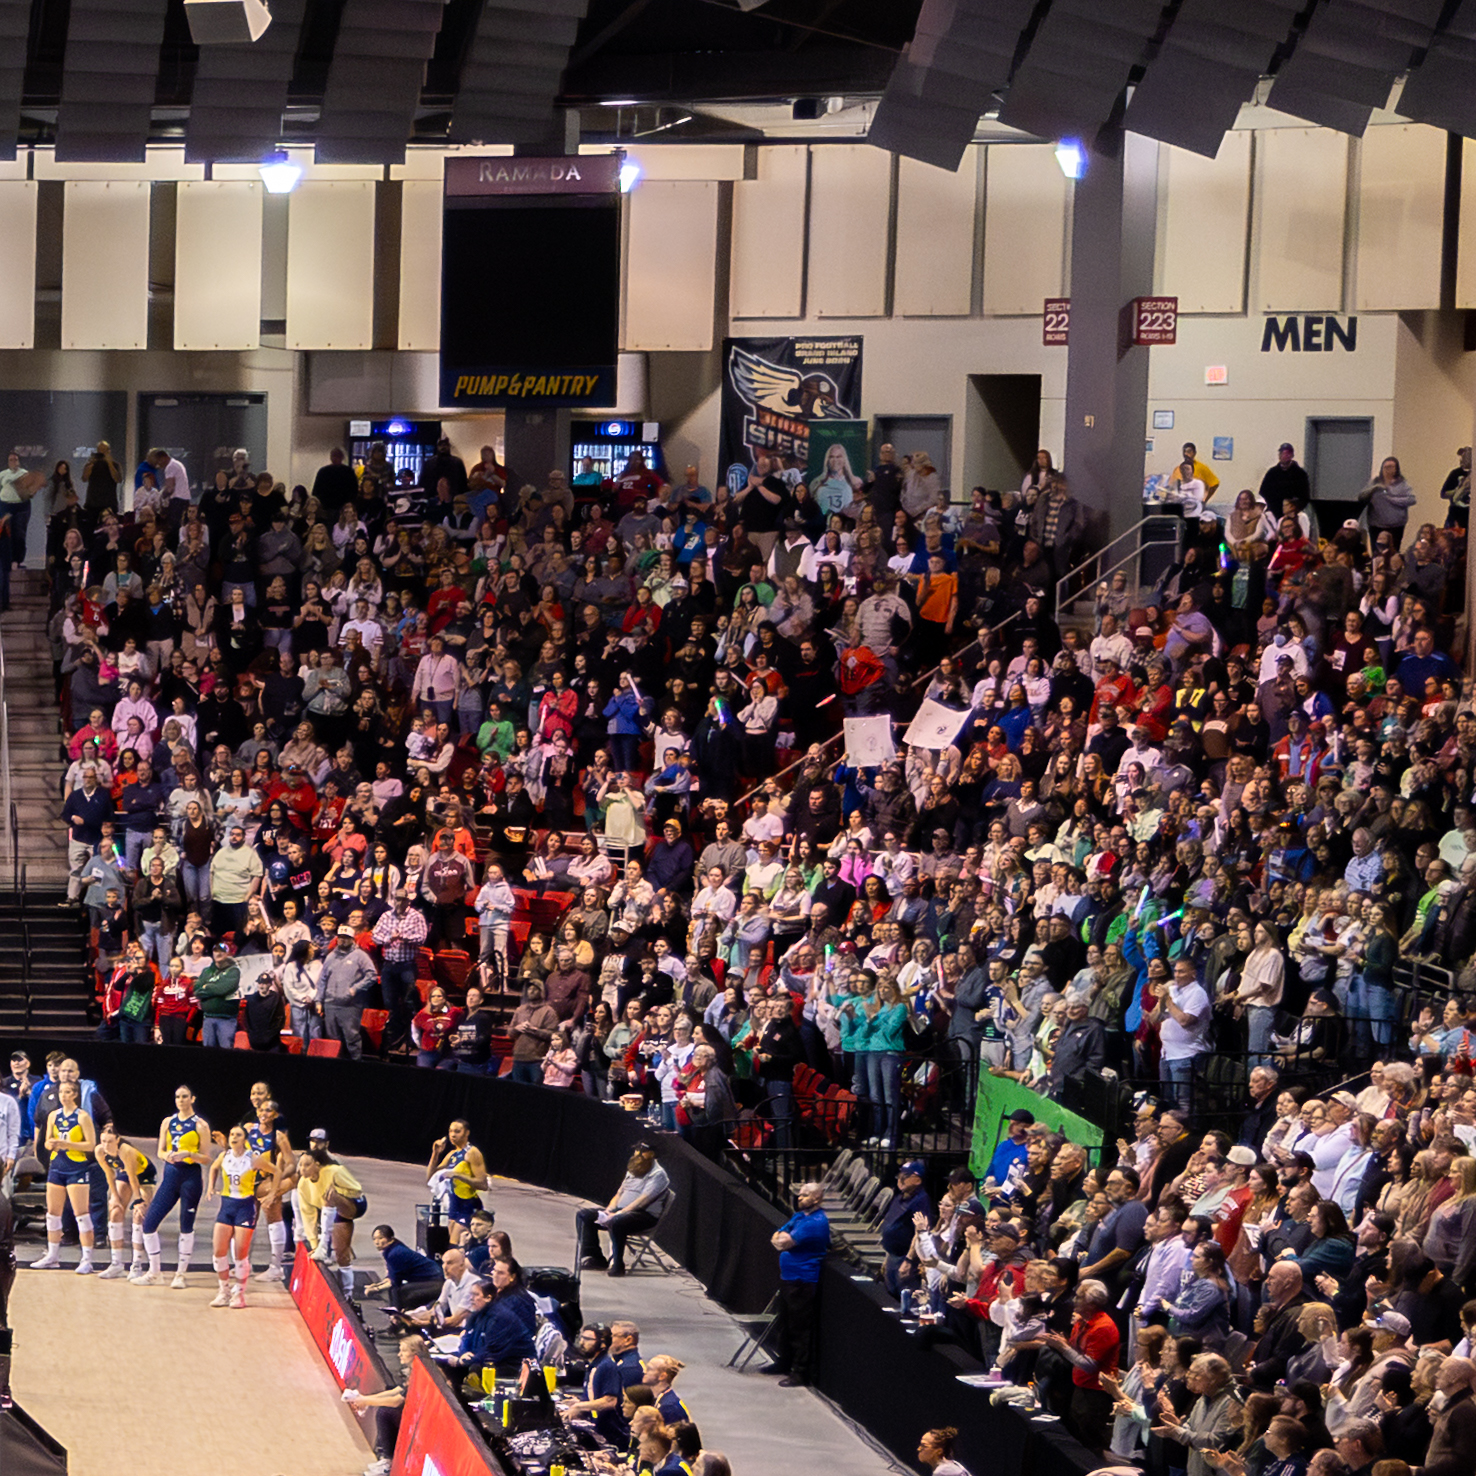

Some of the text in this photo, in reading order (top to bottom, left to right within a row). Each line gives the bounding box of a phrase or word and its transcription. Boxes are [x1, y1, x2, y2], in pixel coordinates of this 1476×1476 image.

[479, 162, 581, 182] RAMADA
[1140, 301, 1175, 310] SECTION
[1045, 313, 1069, 332] 22
[1139, 312, 1176, 330] 223
[1260, 316, 1358, 352] MEN
[453, 373, 599, 398] PUMP&PANTRY
[749, 423, 809, 461] SIEG
